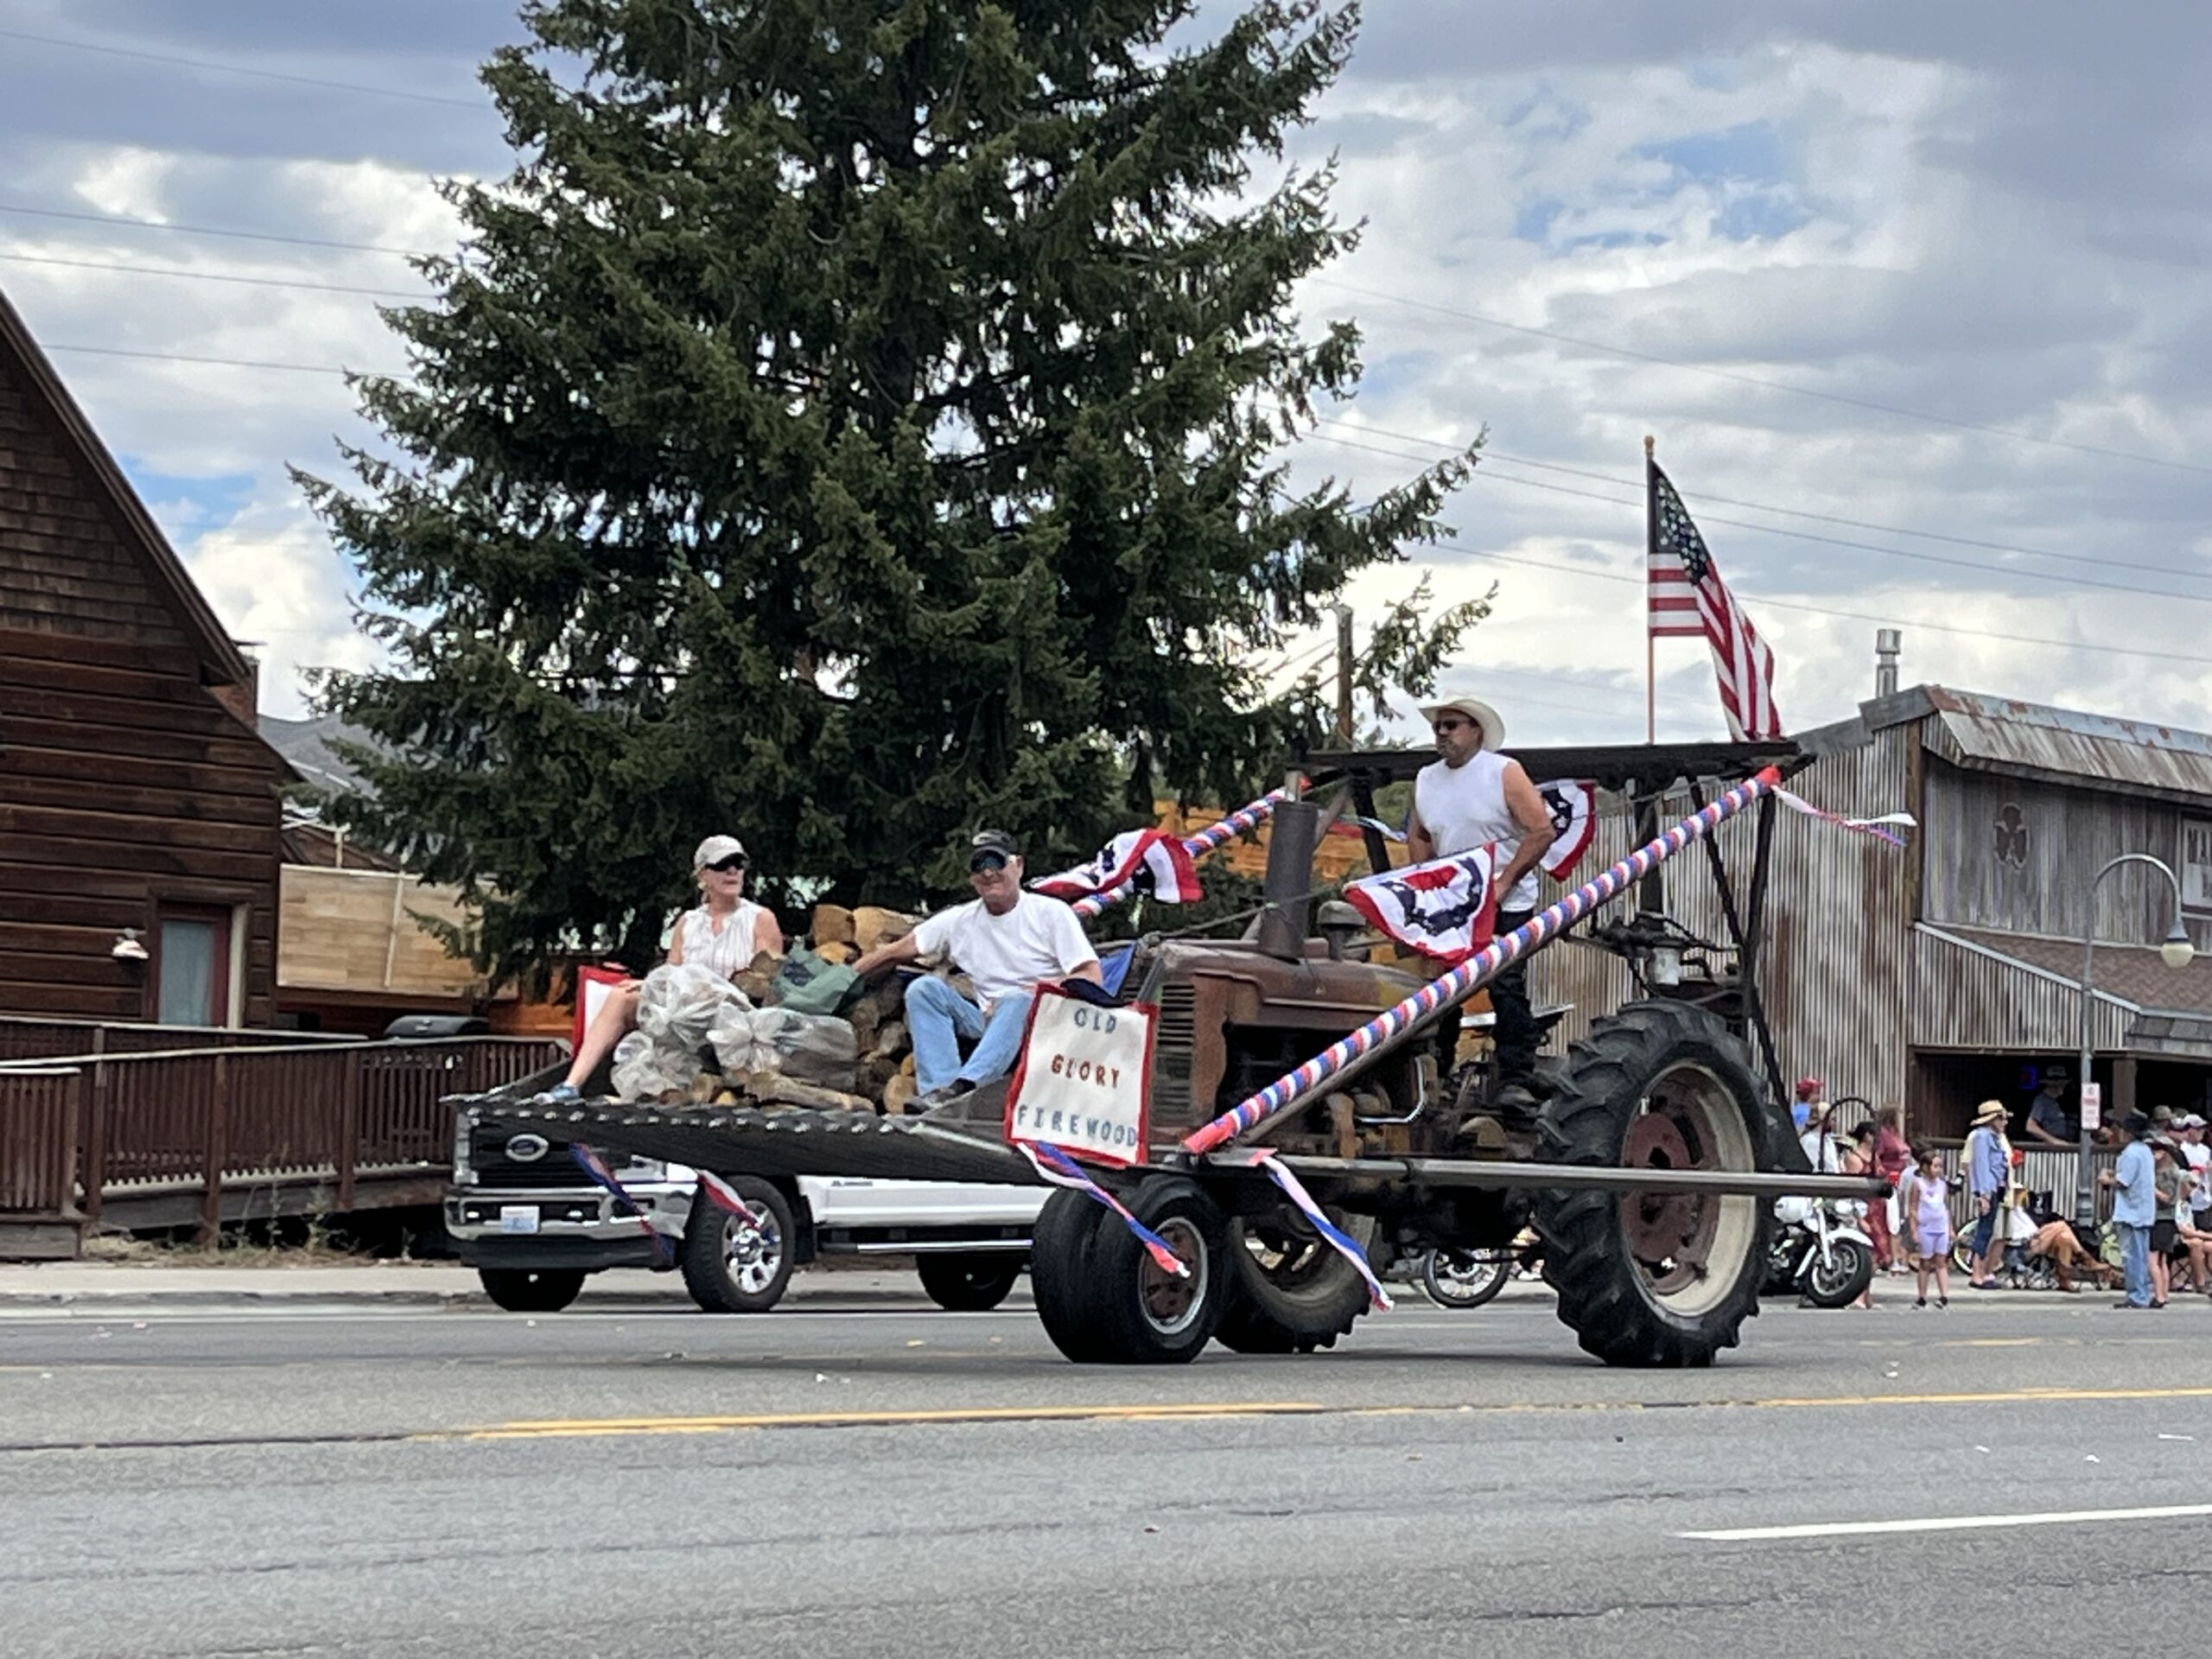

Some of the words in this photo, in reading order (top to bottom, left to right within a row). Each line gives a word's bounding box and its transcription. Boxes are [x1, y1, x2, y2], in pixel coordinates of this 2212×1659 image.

[1074, 1007, 1117, 1033] OLD
[1051, 1053, 1120, 1090] GLORY
[1017, 1104, 1137, 1147] FIREWOOD
